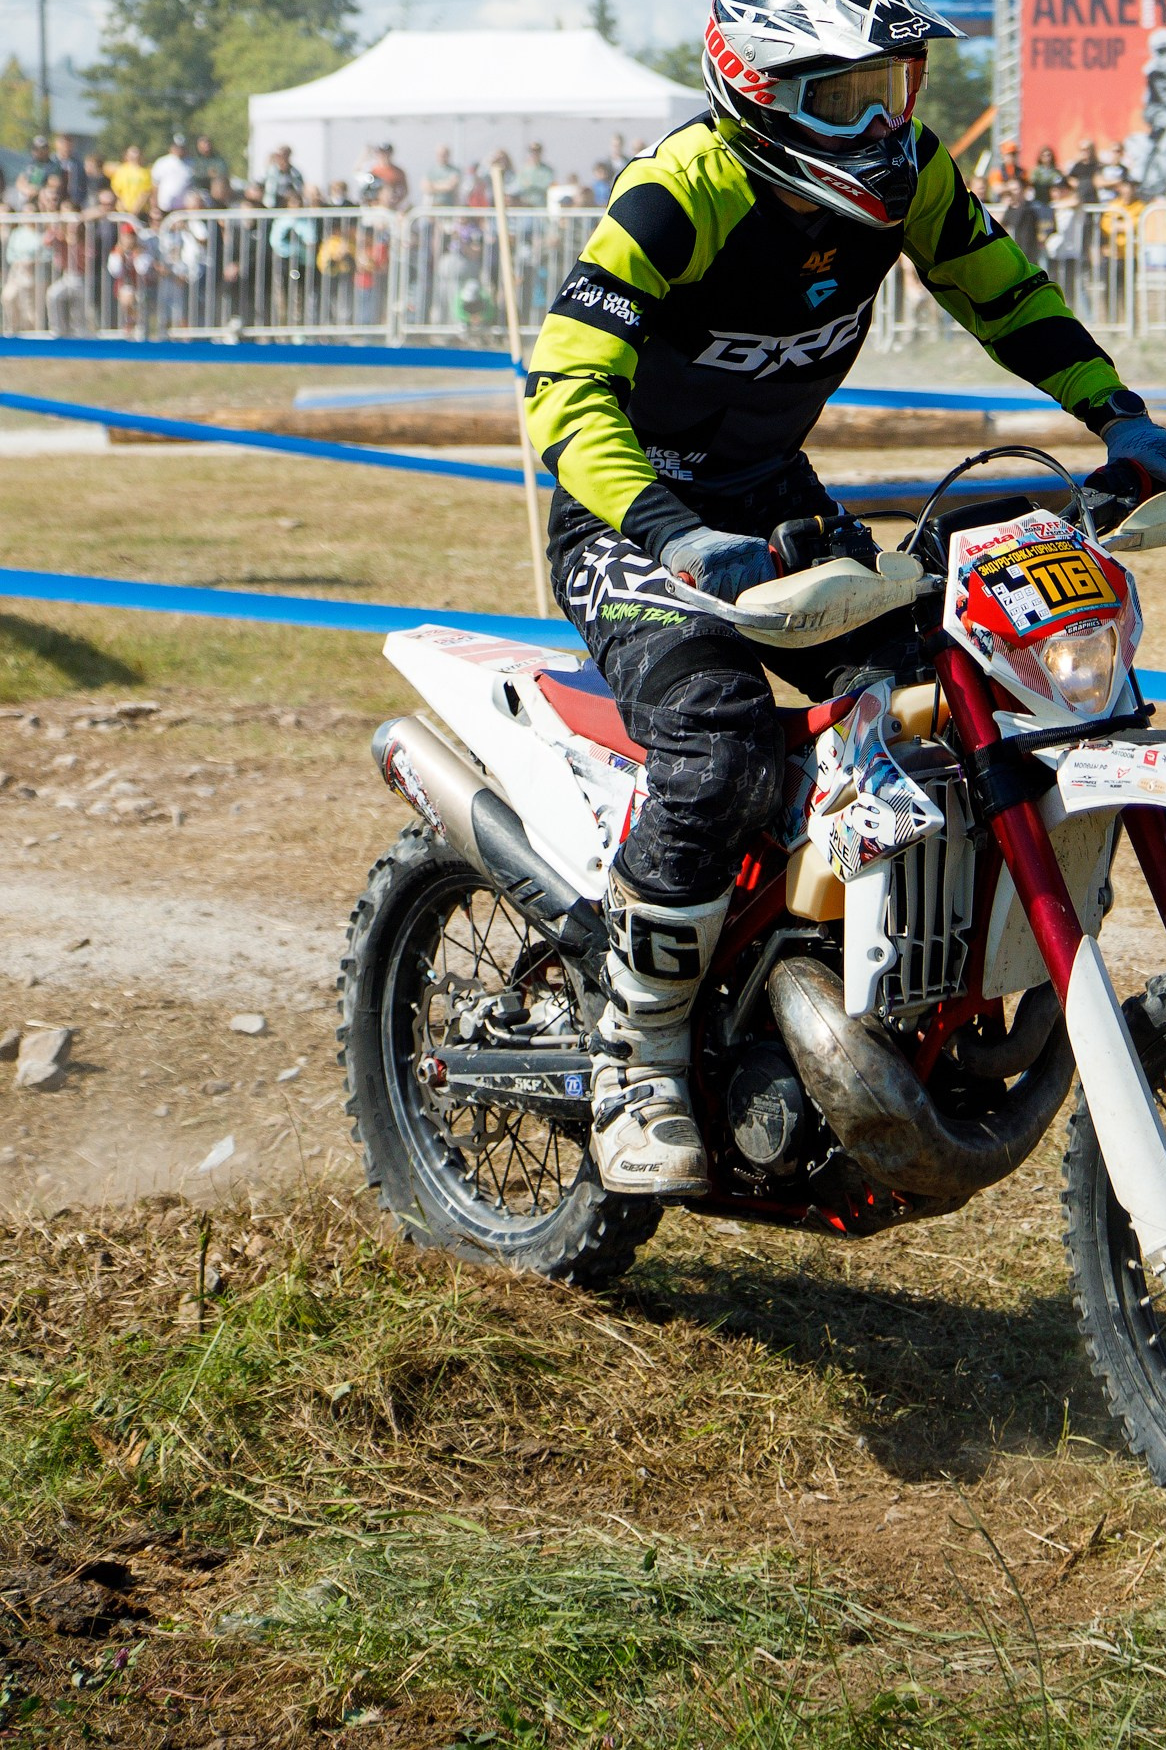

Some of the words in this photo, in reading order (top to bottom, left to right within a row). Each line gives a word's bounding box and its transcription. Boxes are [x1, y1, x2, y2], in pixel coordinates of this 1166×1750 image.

[1030, 38, 1080, 70] FIRE
[1083, 37, 1125, 70] CUP
[821, 176, 864, 196] FOX
[571, 288, 602, 307] my
[965, 533, 1015, 557] Beta
[1031, 560, 1099, 603] 116
[601, 602, 643, 623] RACING
[641, 607, 688, 626] TEAM
[515, 1077, 541, 1092] SKF
